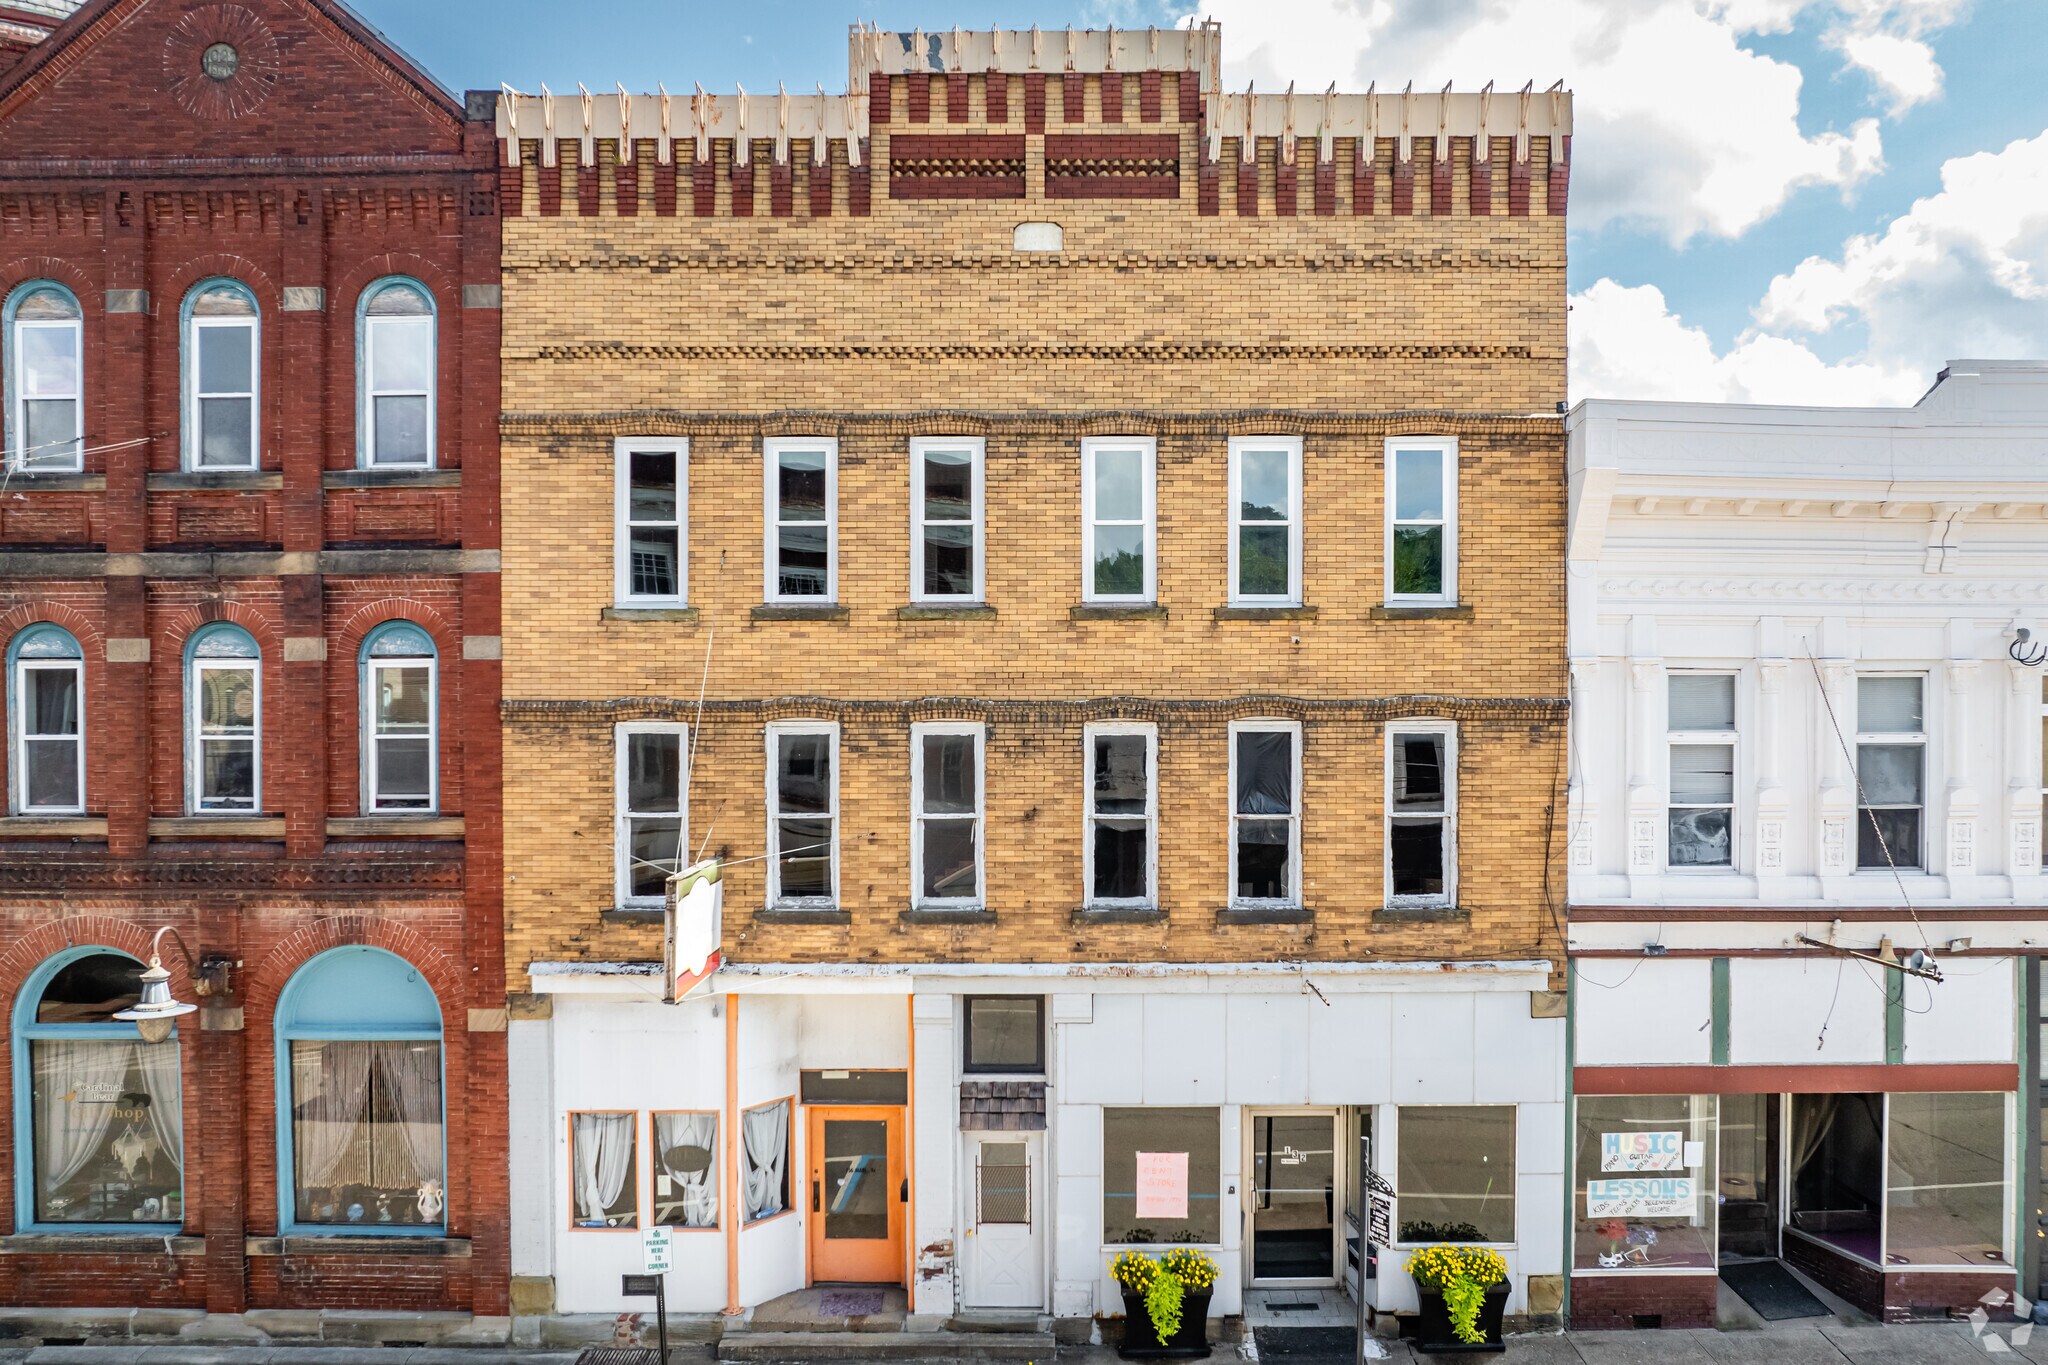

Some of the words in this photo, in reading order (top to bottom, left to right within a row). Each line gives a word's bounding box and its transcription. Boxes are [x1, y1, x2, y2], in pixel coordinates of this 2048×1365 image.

[81, 1083, 125, 1092] Cardinal
[92, 1092, 115, 1101] Bear
[105, 1105, 144, 1122] Shop
[1606, 1134, 1676, 1154] MUSIC
[1604, 1154, 1619, 1171] PIANO
[1591, 1180, 1690, 1200] LESSONS
[1593, 1201, 1610, 1215] KIDS
[1609, 1199, 1628, 1216] TEENS
[1624, 1199, 1641, 1215] ADULTS
